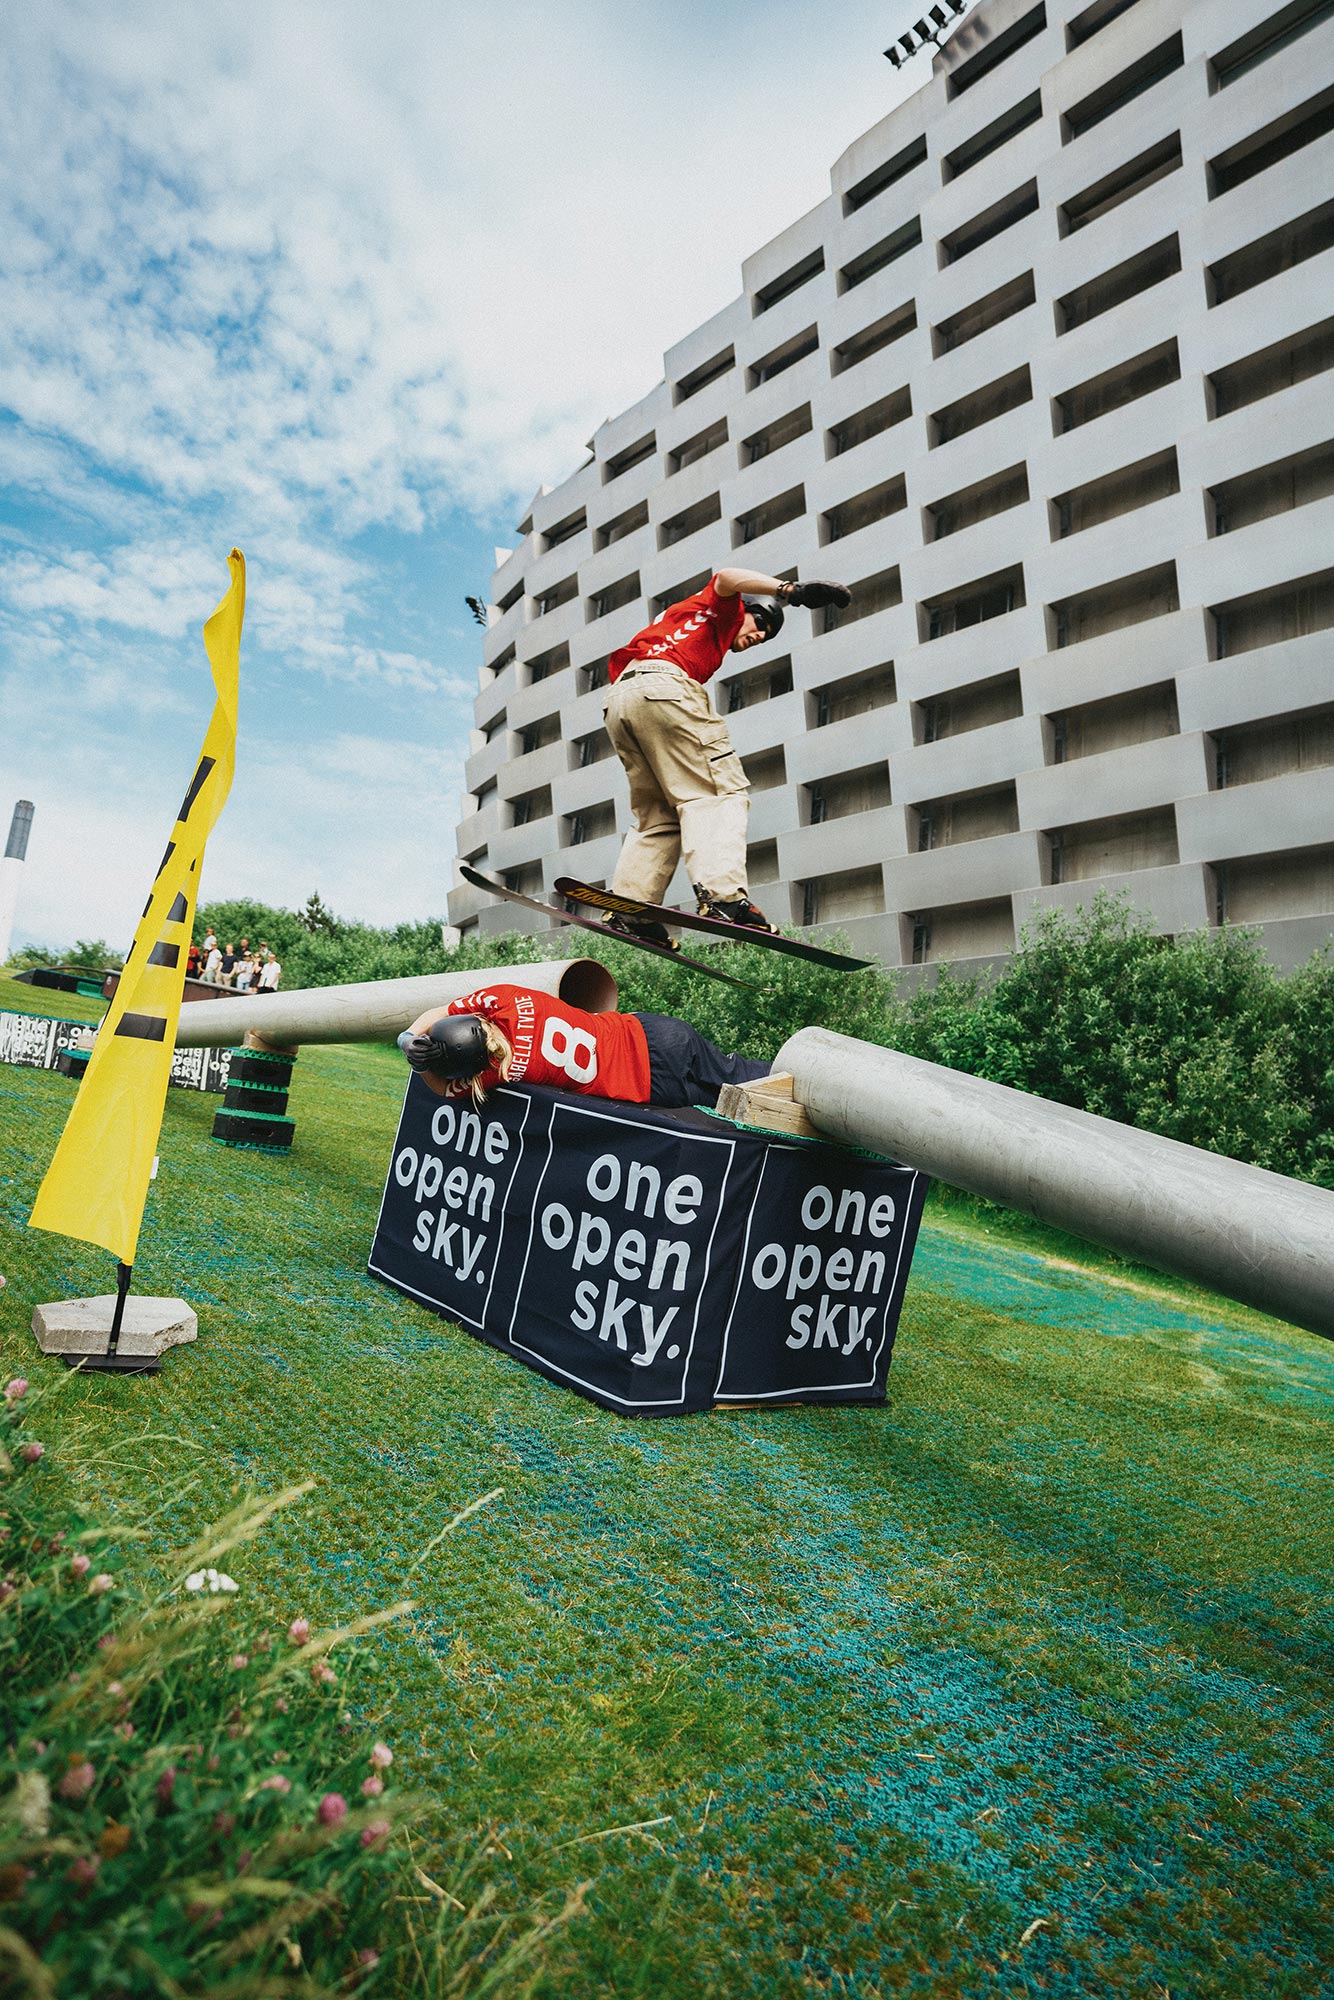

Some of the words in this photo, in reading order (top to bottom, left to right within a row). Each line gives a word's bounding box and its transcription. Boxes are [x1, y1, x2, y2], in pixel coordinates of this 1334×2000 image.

[514, 995, 535, 1030] TVEDE
[57, 1036, 78, 1051] op
[209, 1061, 230, 1074] op
[541, 1016, 597, 1084] 8
[431, 1104, 509, 1164] one
[395, 1146, 496, 1222] open
[586, 1154, 704, 1224] one
[801, 1185, 896, 1238] one
[412, 1209, 487, 1284] sky.
[541, 1203, 690, 1291] open
[751, 1243, 887, 1300] open
[570, 1280, 680, 1367] sky.
[787, 1295, 876, 1355] sky.
